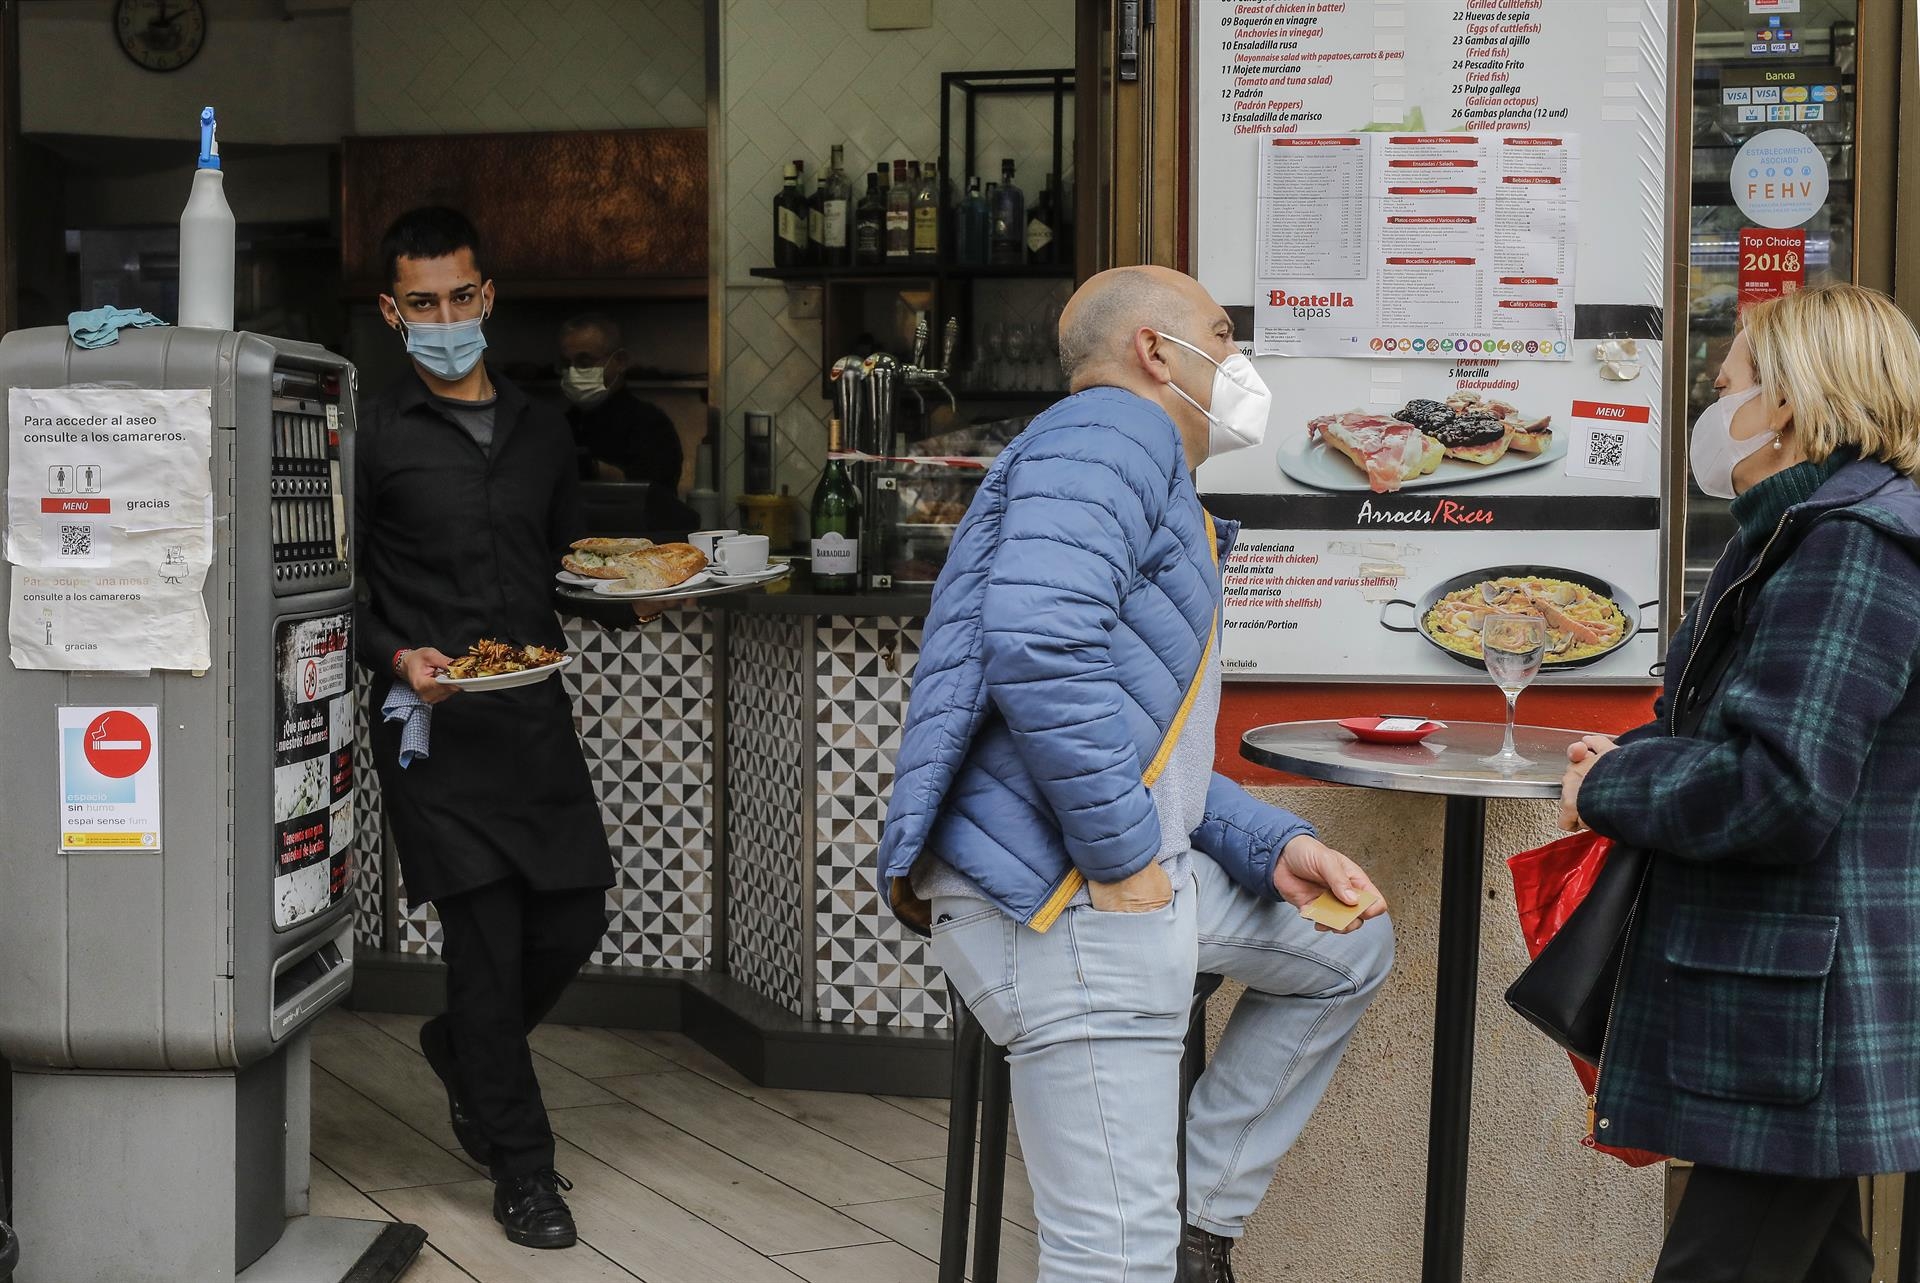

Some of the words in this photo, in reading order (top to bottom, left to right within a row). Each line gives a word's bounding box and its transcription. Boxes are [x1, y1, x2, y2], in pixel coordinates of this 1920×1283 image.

[1234, 4, 1264, 14] (Breast
[1265, 4, 1274, 14] of
[1276, 3, 1306, 13] chicken
[1307, 3, 1315, 12] in
[1317, 3, 1345, 13] batter)
[1221, 18, 1231, 26] 09
[1233, 17, 1273, 28] Boquerón
[1286, 17, 1317, 26] vinagre
[1453, 12, 1463, 20] 22
[1465, 12, 1494, 21] Huevas
[1496, 12, 1506, 21] de
[1508, 12, 1529, 23] sepia
[1234, 28, 1277, 38] (Anchovies
[1279, 28, 1288, 36] in
[1289, 27, 1323, 37] vinegar)
[1466, 24, 1487, 35] (Eggs
[1490, 24, 1500, 33] of
[1500, 24, 1542, 34] cuttlefish)
[1222, 42, 1231, 50] 10
[1233, 41, 1277, 50] Ensaladilla
[1465, 36, 1498, 45] Gambas
[1500, 36, 1507, 44] al
[1509, 36, 1530, 47] ajillo
[1234, 53, 1279, 63] (Mayonnaise
[1281, 53, 1299, 61] salad
[1385, 51, 1404, 60] peas)
[1466, 48, 1490, 58] (Fried
[1492, 48, 1509, 58] fish)
[1452, 61, 1463, 69] 24
[1465, 60, 1503, 69] Pescadito
[1505, 61, 1524, 69] Frito
[1222, 65, 1230, 74] 11
[1233, 65, 1261, 76] Mojete
[1262, 65, 1300, 73] murciano
[1234, 76, 1268, 87] (Tomato
[1270, 76, 1285, 85] and
[1286, 77, 1306, 85] tuna
[1307, 75, 1333, 86] salad)
[1466, 72, 1490, 82] (Fried
[1492, 72, 1509, 82] fish)
[1765, 72, 1795, 81] Bankia
[1222, 90, 1231, 98] 12
[1234, 88, 1263, 98] Padrón
[1452, 85, 1463, 94] 25
[1464, 85, 1488, 96] Pulpo
[1490, 85, 1521, 96] gallega
[1727, 92, 1748, 100] VISA
[1756, 89, 1777, 98] VISA
[1234, 100, 1266, 111] (Padrón
[1267, 100, 1303, 111] Peppers)
[1466, 96, 1501, 107] (Galician
[1503, 96, 1539, 107] octopus)
[1222, 114, 1231, 122] 13
[1233, 113, 1277, 122] Ensaladilla
[1279, 112, 1289, 121] de
[1291, 113, 1322, 121] marisco
[1452, 109, 1462, 118] 26
[1464, 109, 1497, 118] Gambas
[1499, 108, 1532, 120] plancha
[1534, 109, 1547, 119] (12
[1549, 108, 1568, 119] und)
[1234, 124, 1271, 134] (Shellfish
[1273, 124, 1298, 134] salad)
[1465, 121, 1495, 131] (Grilled
[1497, 121, 1530, 131] prawns)
[1746, 148, 1812, 156] ESTABLECIMIENTO
[1744, 237, 1762, 248] Top
[1766, 237, 1801, 247] Choice
[1270, 290, 1354, 307] Boatella
[1293, 307, 1331, 320] tapas
[1449, 369, 1454, 377] 5
[1455, 369, 1489, 378] Morcilla
[1456, 380, 1519, 390] (Blackpudding)
[1596, 407, 1626, 417] MENÚ
[24, 416, 52, 426] Para
[56, 415, 108, 426] acceder
[111, 415, 122, 426] al
[126, 416, 157, 425] aseo
[24, 432, 78, 443] consulte
[80, 434, 88, 442] a
[91, 431, 110, 442] los
[112, 432, 186, 442] camareros.
[62, 500, 89, 511] MENÚ
[127, 499, 170, 510] gracias
[1251, 544, 1294, 552] valenciana
[1250, 554, 1264, 563] rice
[1265, 554, 1283, 563] with
[1285, 554, 1319, 565] chicken)
[1224, 565, 1248, 574] Paella
[1250, 565, 1274, 574] mixta
[1225, 576, 1247, 587] (Fried
[1250, 577, 1264, 586] rice
[1265, 576, 1283, 586] with
[1285, 576, 1315, 586] chicken
[1317, 577, 1331, 586] and
[1333, 577, 1359, 586] varius
[1360, 577, 1397, 587] shellfish)
[23, 593, 63, 601] consulte
[1224, 587, 1248, 596] Paella
[1250, 588, 1281, 596] marisco
[1225, 598, 1247, 608] (Fried
[1250, 599, 1264, 607] rice
[1265, 598, 1283, 607] with
[1285, 598, 1322, 609] shellfish)
[1224, 620, 1237, 629] Por
[1239, 620, 1298, 629] ración/Portion
[65, 643, 97, 652] gracias
[68, 804, 83, 812] sin
